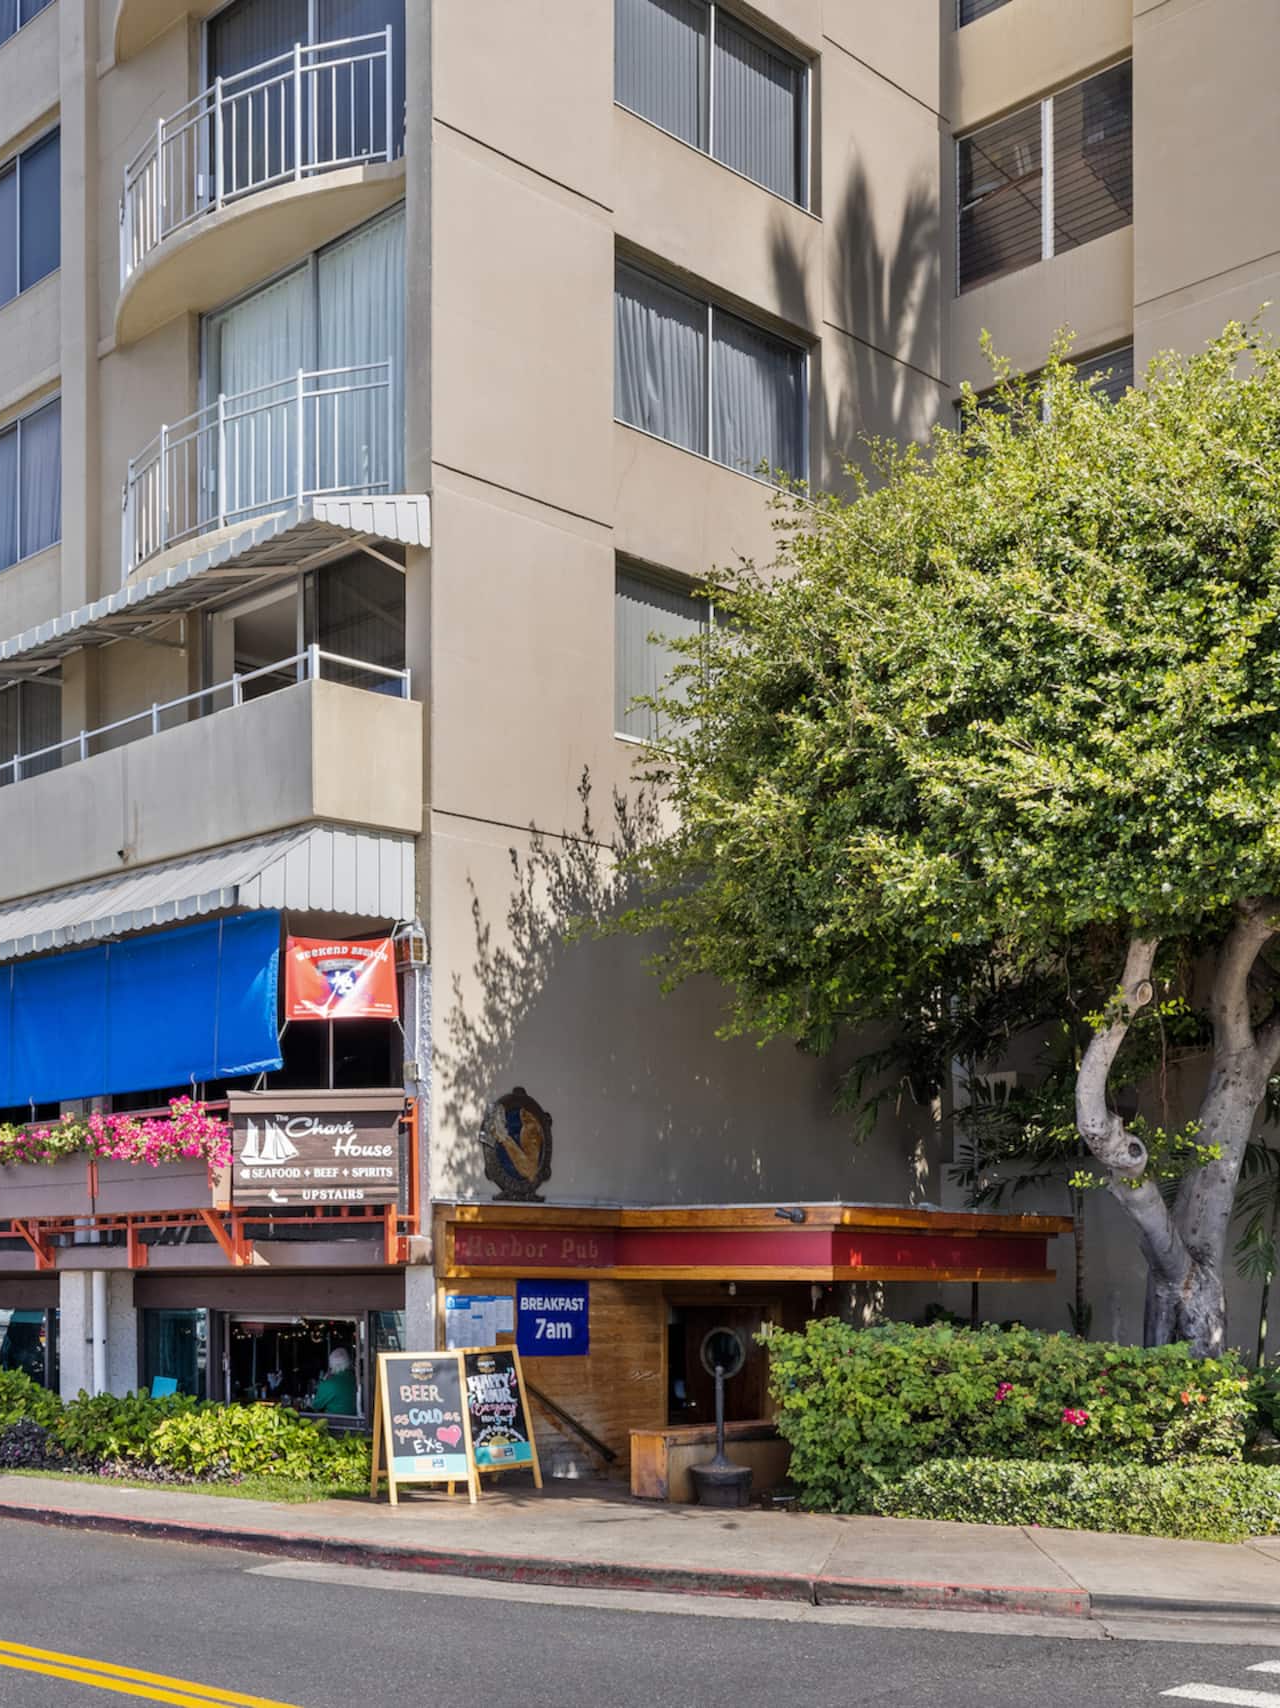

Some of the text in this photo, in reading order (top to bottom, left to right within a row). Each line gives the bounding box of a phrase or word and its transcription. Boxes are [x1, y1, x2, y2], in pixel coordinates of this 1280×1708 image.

[285, 1116, 355, 1138] Chart
[332, 1134, 393, 1157] House
[252, 1167, 393, 1179] SEAFOOD BEEF SPIRITS
[302, 1189, 364, 1200] UPSTAIRS
[464, 1234, 599, 1259] Harbor Pub
[520, 1297, 585, 1311] BREAKFAST
[535, 1318, 573, 1340] 7am
[467, 1373, 511, 1392] HAPPY
[400, 1385, 444, 1402] BEER
[476, 1388, 518, 1404] HOUR
[409, 1408, 443, 1425] COLD
